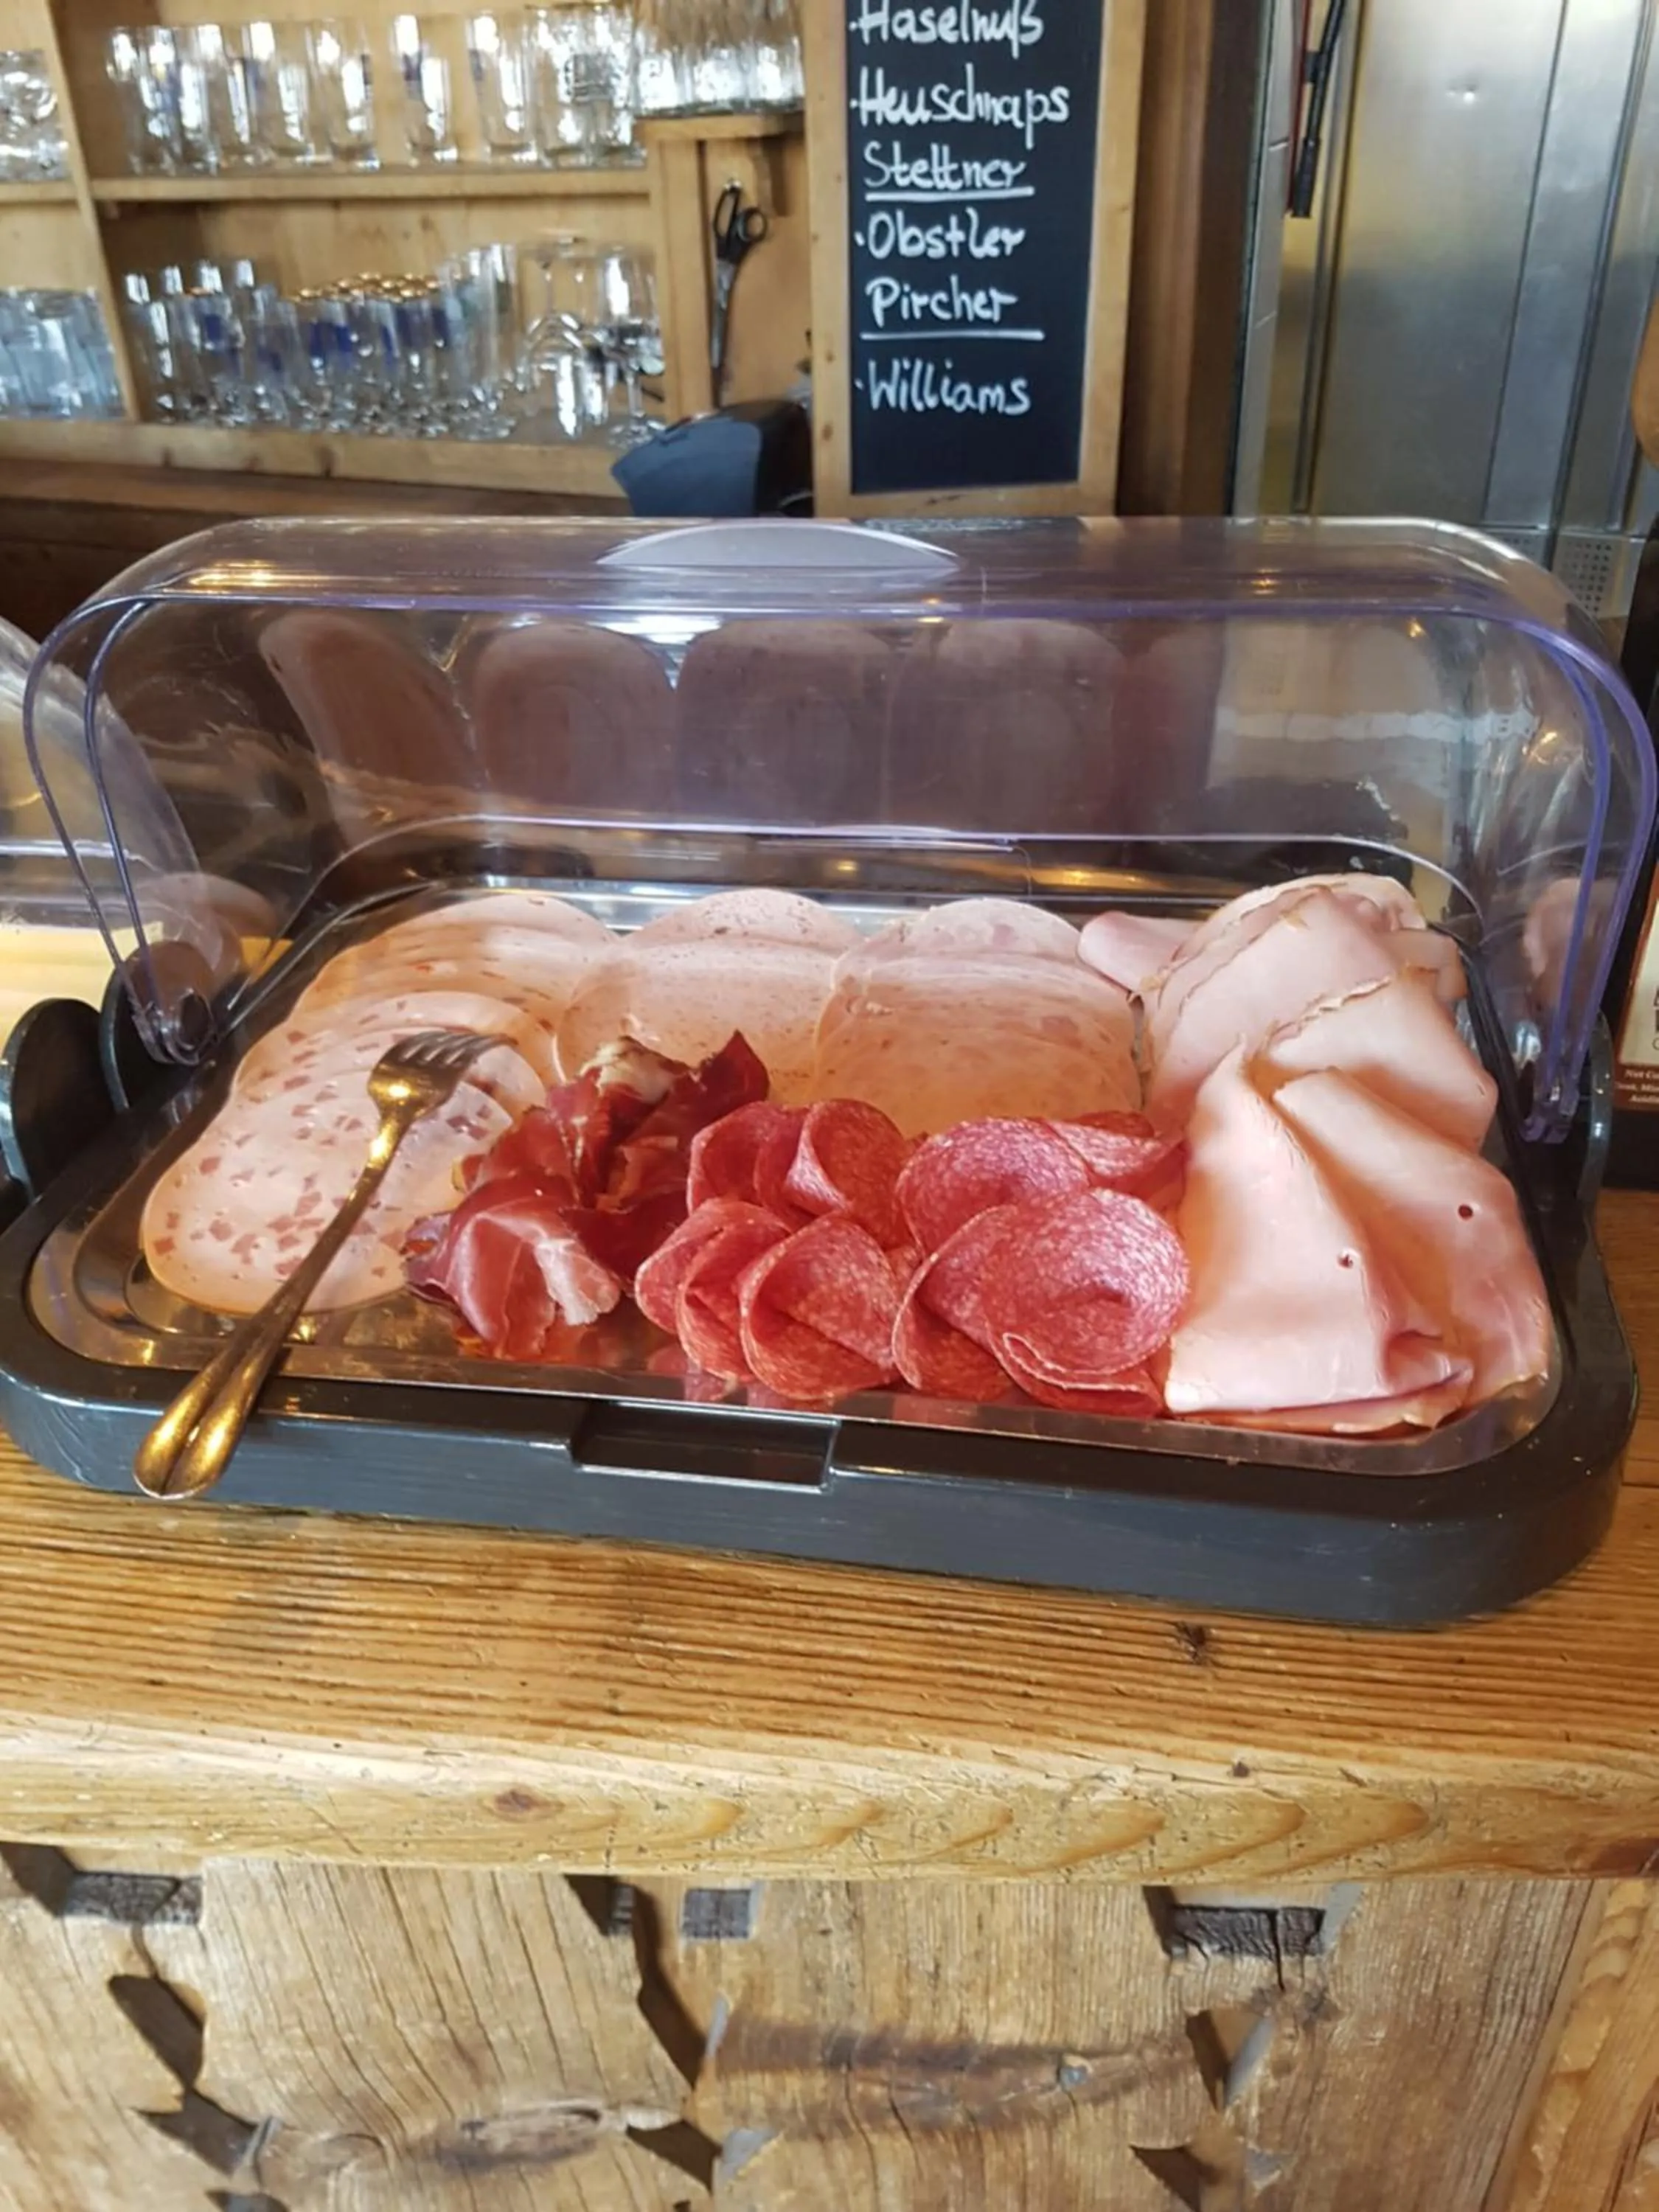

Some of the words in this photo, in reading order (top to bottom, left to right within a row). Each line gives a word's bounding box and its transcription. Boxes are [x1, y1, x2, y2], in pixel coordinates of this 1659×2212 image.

[864, 141, 1026, 190] Stettner
[869, 207, 1025, 259] Obstler
[866, 275, 1018, 327] Pircher
[869, 358, 1032, 415] Williams
